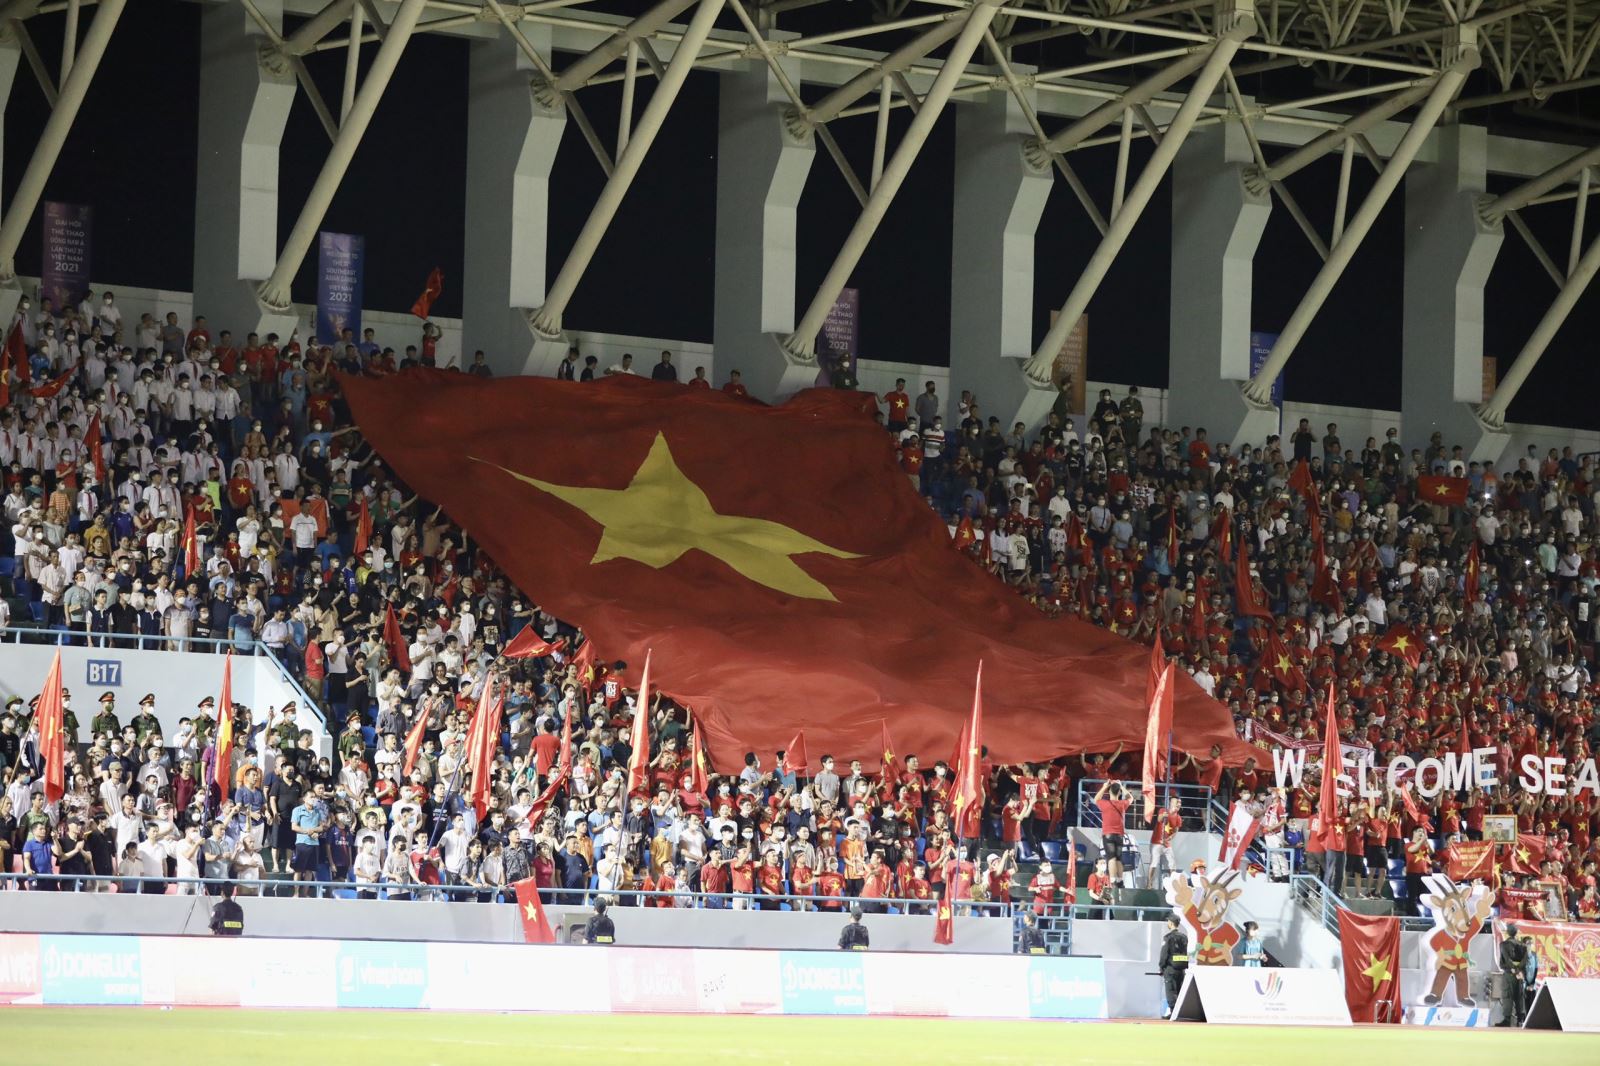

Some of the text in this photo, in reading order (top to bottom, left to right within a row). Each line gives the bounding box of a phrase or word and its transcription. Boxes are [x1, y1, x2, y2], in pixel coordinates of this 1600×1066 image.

[55, 261, 79, 272] 2021
[329, 292, 352, 302] 2021
[828, 341, 849, 351] 2021
[90, 663, 119, 683] B17
[1272, 746, 1600, 798] WELCOME SEA
